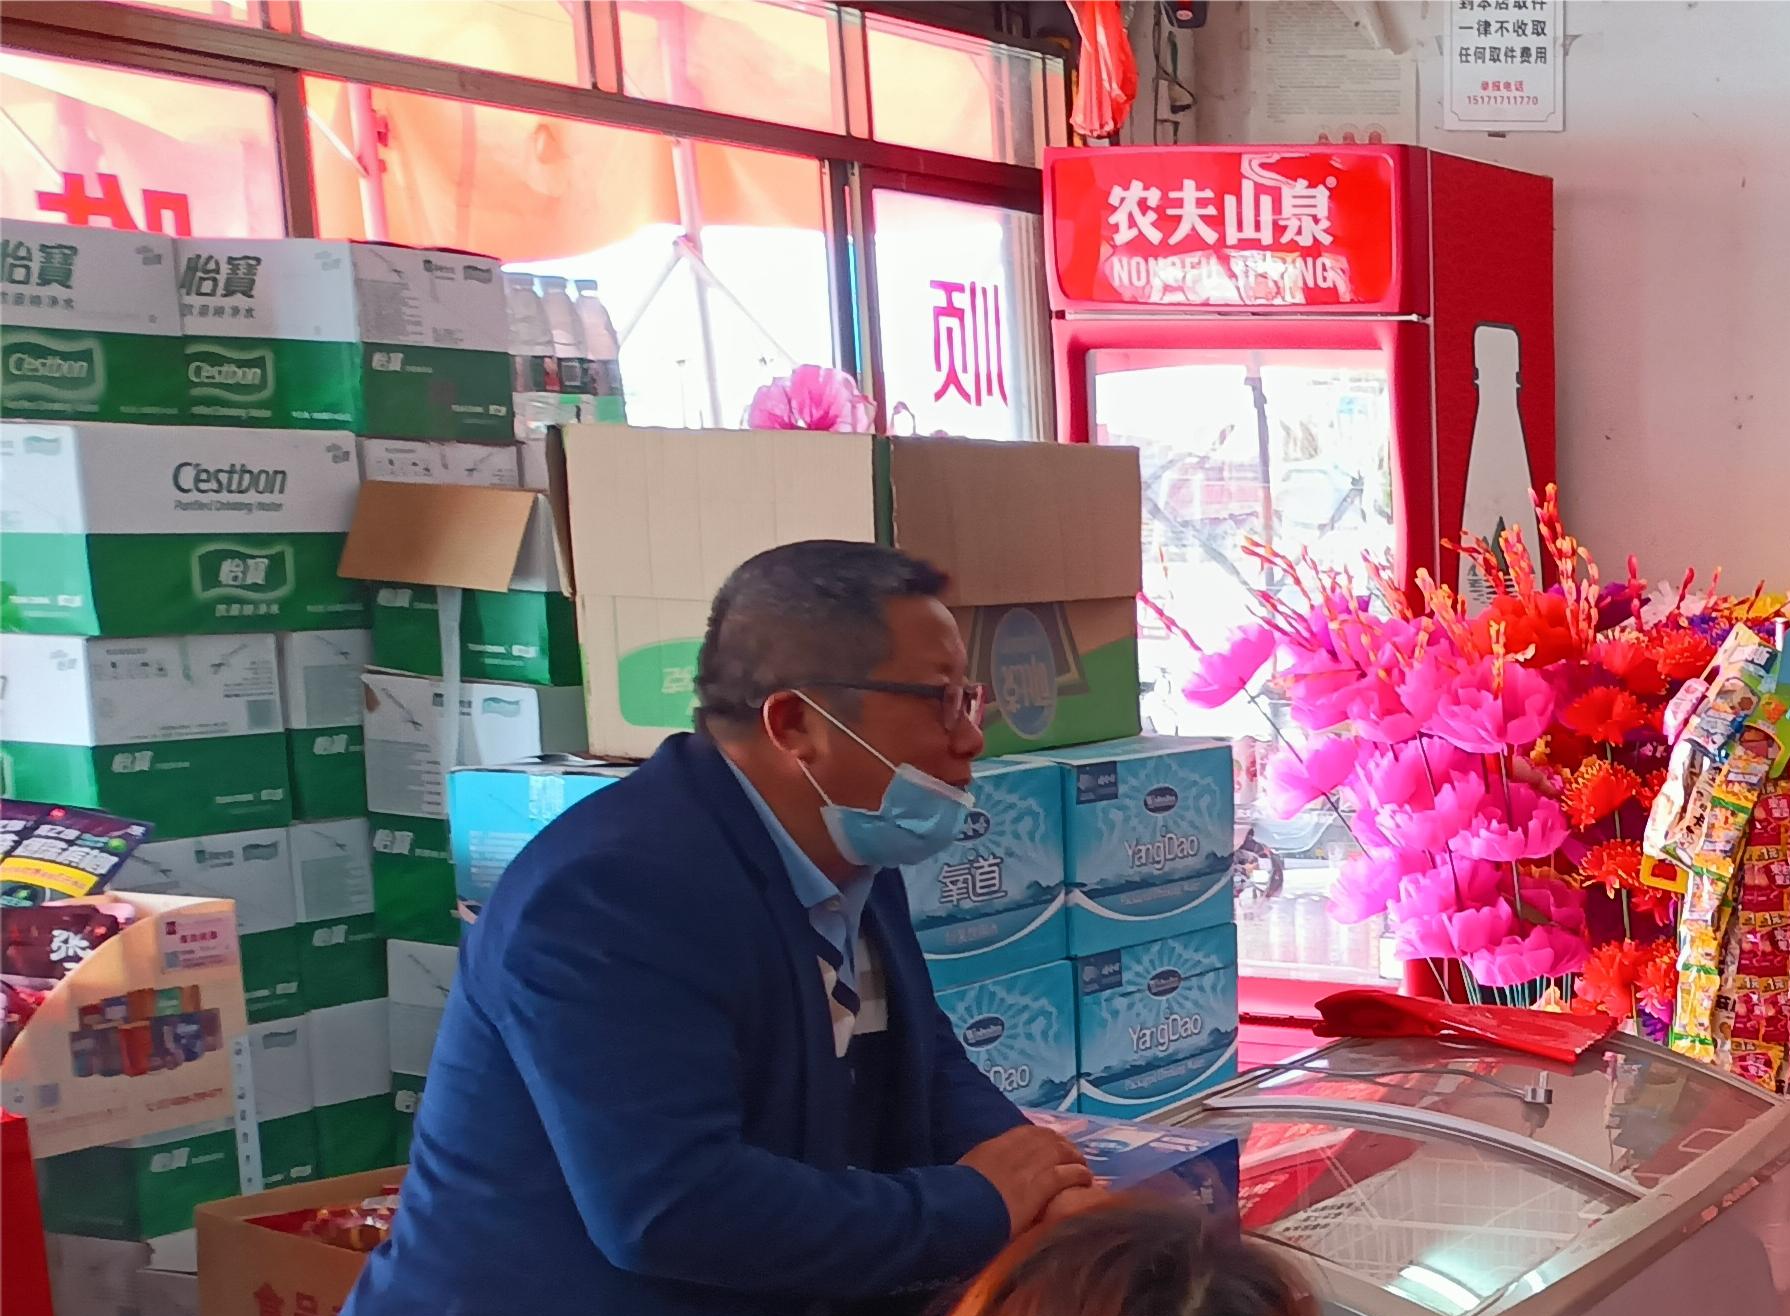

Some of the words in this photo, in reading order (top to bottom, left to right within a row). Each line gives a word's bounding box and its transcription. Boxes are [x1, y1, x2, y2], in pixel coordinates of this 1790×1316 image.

[1458, 19, 1547, 38] 一律不收取
[1458, 46, 1547, 65] 任何取件费用
[1107, 178, 1334, 247] 农夫山泉
[1124, 833, 1199, 871] YangDao
[1129, 1012, 1201, 1052] YangDao
